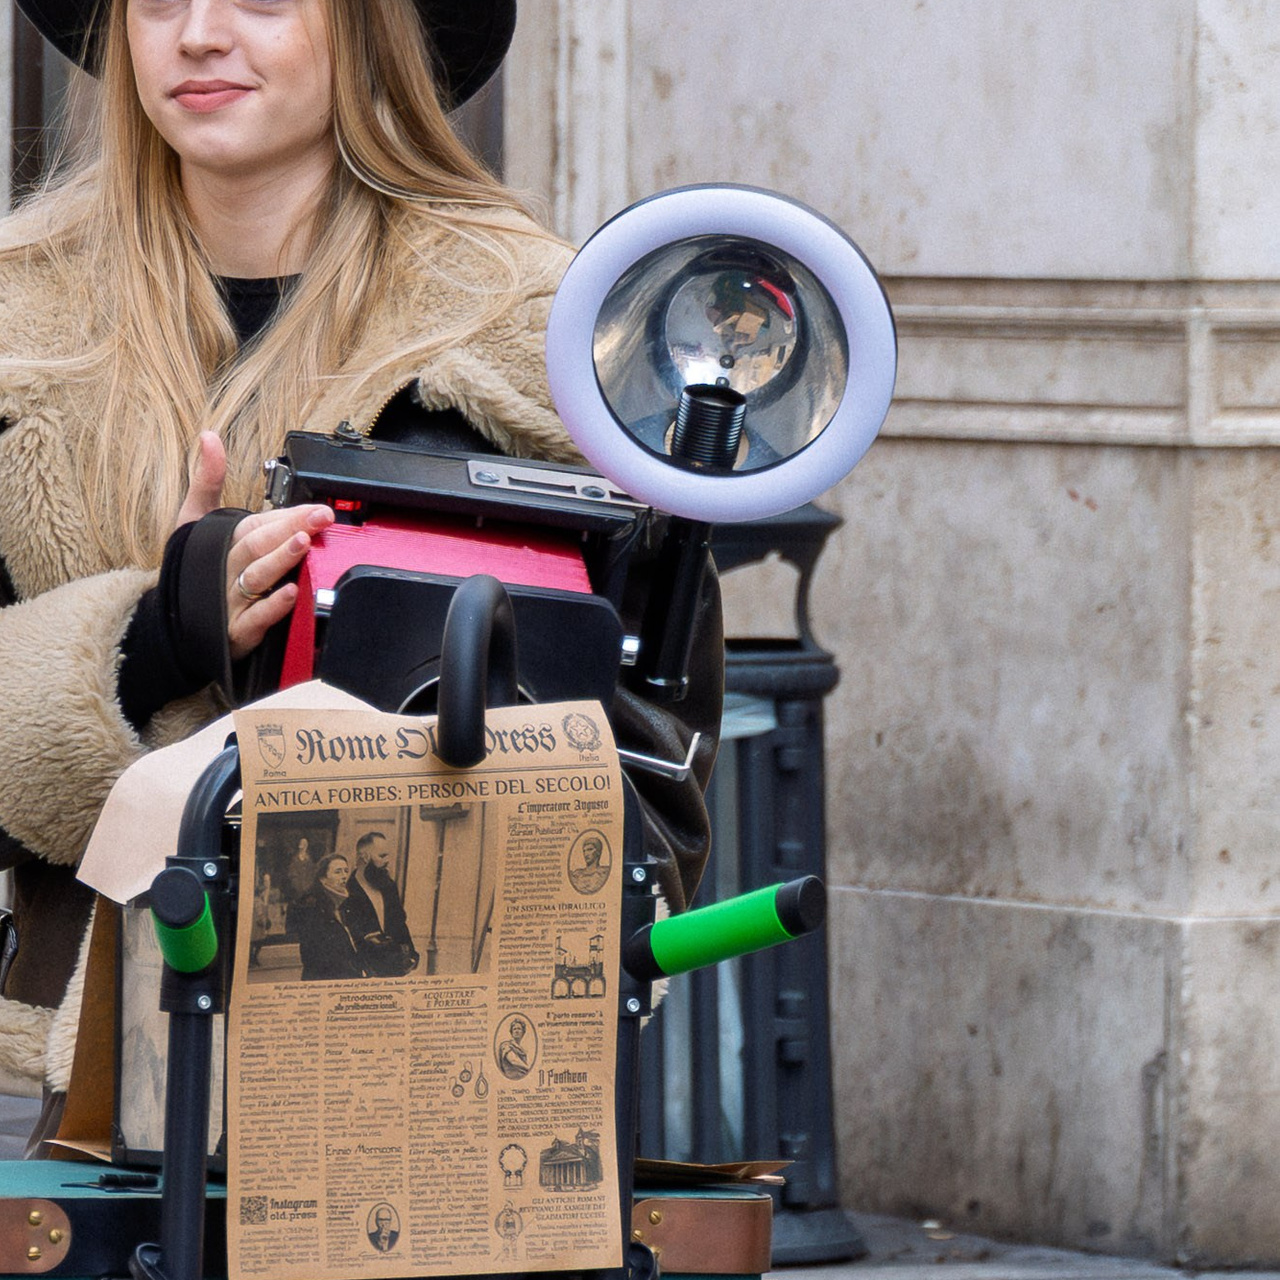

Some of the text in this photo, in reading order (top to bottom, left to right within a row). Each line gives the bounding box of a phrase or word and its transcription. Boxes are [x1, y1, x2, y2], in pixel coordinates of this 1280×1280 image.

[296, 729, 390, 765] Rome
[395, 725, 439, 760] Ol
[255, 775, 611, 807] ANTICA FORBES: PERSONE DEL SECOLO!
[558, 903, 606, 911] IDRAULICO
[325, 1144, 351, 1156] Ennio
[270, 1198, 318, 1212] Instagram
